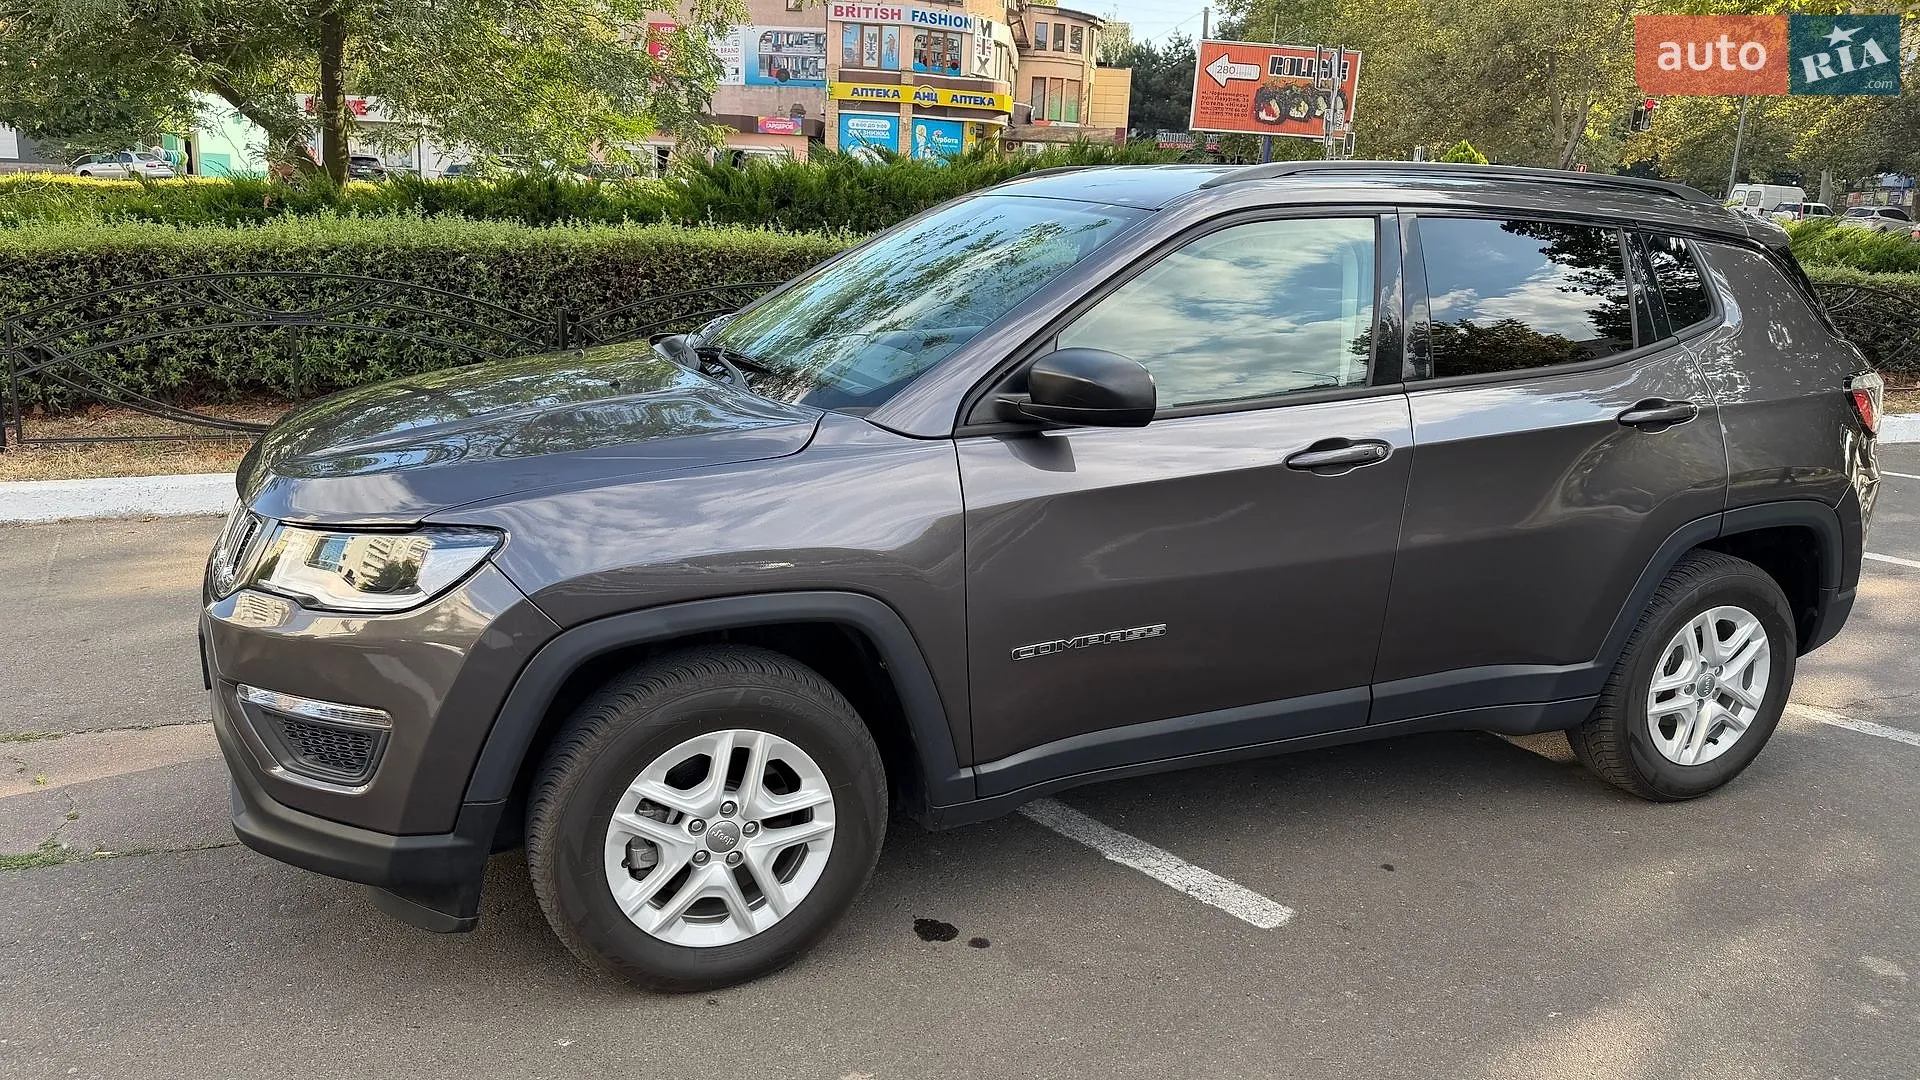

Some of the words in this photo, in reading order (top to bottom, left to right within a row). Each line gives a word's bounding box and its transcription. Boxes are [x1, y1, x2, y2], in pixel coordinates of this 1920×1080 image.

[834, 5, 902, 20] BRITISH
[911, 9, 973, 29] FASHION
[977, 18, 993, 75] MIX
[1216, 65, 1236, 74] 280
[851, 87, 901, 99] АПТЕКА
[914, 91, 938, 104] АНЦ
[950, 94, 995, 107] АПТЕКА
[1012, 623, 1167, 660] COMPASS
[711, 829, 736, 845] Jeep
